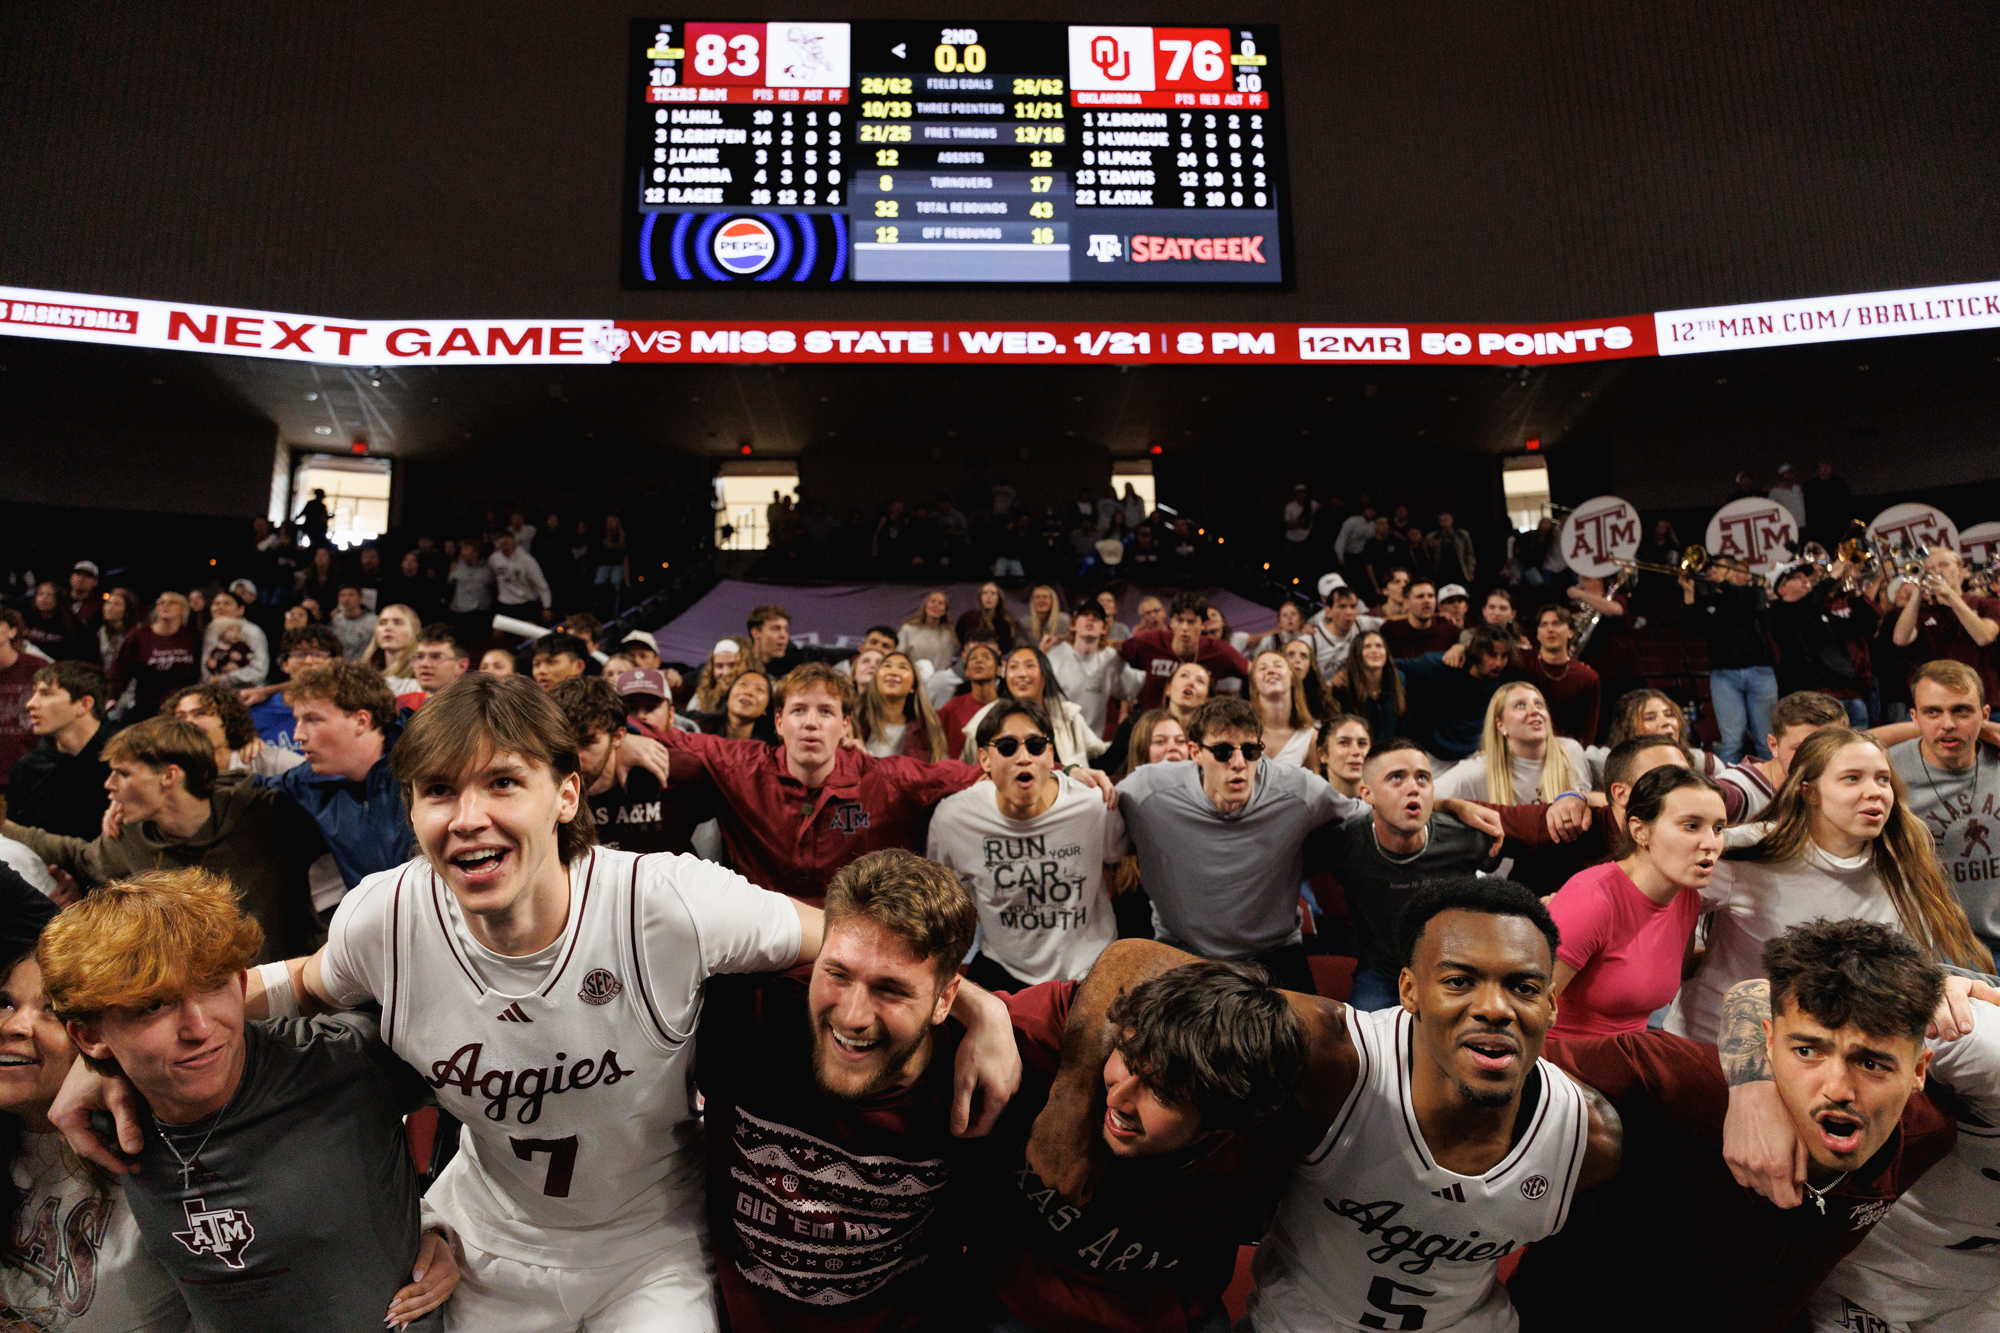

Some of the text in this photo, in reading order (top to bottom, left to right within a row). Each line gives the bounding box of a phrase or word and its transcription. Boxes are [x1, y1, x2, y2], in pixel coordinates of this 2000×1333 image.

[655, 33, 670, 51] 2
[941, 29, 978, 44] 2ND
[694, 34, 759, 76] 83
[1241, 40, 1255, 57] 0
[935, 44, 986, 73] 0.0
[1091, 36, 1130, 80] OU
[1159, 40, 1224, 81] 76
[650, 68, 676, 86] 10
[1236, 74, 1262, 92] 10
[652, 88, 697, 101] TEXAS
[753, 89, 773, 101] PTS
[778, 90, 799, 101] REB
[803, 90, 823, 101] AST
[829, 90, 843, 101] PF
[861, 78, 1063, 96] 26/62 FIELD GOALS 26/62
[1077, 93, 1262, 106] OKLAHOMA PTS REB AST PF
[655, 109, 841, 126] 0 M.HILL 10 1 1 0
[862, 101, 912, 119] 10/33
[1014, 102, 1064, 120] 11/31
[1083, 112, 1262, 129] 1 X.BROWN 7 3 2 2
[655, 128, 667, 143] 3
[752, 130, 772, 145] 14
[781, 130, 793, 145] 2
[805, 130, 817, 145] 0
[829, 131, 841, 145] 3
[860, 125, 911, 143] 21/25
[924, 128, 951, 138] FREE
[1015, 127, 1065, 144] 13/16
[1083, 131, 1264, 148] 5 M.WAGUE 5 5 0 4
[654, 148, 666, 162] 5
[755, 149, 767, 164] 3
[782, 150, 793, 164] 1
[805, 150, 817, 164] 5
[829, 150, 841, 165] 3
[876, 149, 1052, 167] 12 ASSISTS 12
[1083, 150, 1265, 167] 9 N.PACK 24 6 5 4
[653, 167, 666, 182] 6
[754, 169, 767, 184] 4
[781, 169, 793, 184] 3
[805, 169, 817, 184] 0
[828, 169, 841, 184] 0
[879, 175, 893, 191] 8
[1030, 176, 1053, 192] 17
[1076, 170, 1266, 187] 13 T.DAVIS 12 10 1 2
[645, 188, 665, 203] 12
[751, 189, 771, 204] 16
[777, 189, 797, 204] 12
[804, 190, 815, 204] 2
[827, 190, 840, 204] 4
[1076, 190, 1266, 207] 22 K.ATAK 2 10 0 0
[875, 201, 898, 217] 32
[916, 202, 949, 213] TOTAL
[1029, 202, 1053, 218] 43
[876, 226, 898, 243] 12
[922, 228, 943, 238] OFF
[1031, 228, 1054, 244] 16
[720, 241, 769, 251] PEPSI
[1131, 234, 1266, 263] SEATGEEK
[10, 303, 132, 331] BASKETBALL
[168, 311, 584, 358] NEXT GAME
[632, 331, 1275, 355] VS MISS STATE WED. 1/21 8 PM
[1421, 327, 1632, 355] 50 POINTS
[1303, 336, 1401, 353] 12MR
[617, 801, 662, 824] A&M
[987, 835, 1045, 860] RUN
[1050, 846, 1081, 859] YOUR
[994, 862, 1060, 888] CAR
[1028, 877, 1086, 904] NOT
[1000, 907, 1086, 930] MOUTH
[586, 972, 612, 995] SEC
[425, 1042, 635, 1124] Aggies
[509, 1135, 578, 1198] 7
[1523, 1177, 1545, 1197] SEC
[737, 1191, 777, 1226] GIG
[1324, 1197, 1515, 1274] Aggies
[1359, 1275, 1435, 1330] 5
